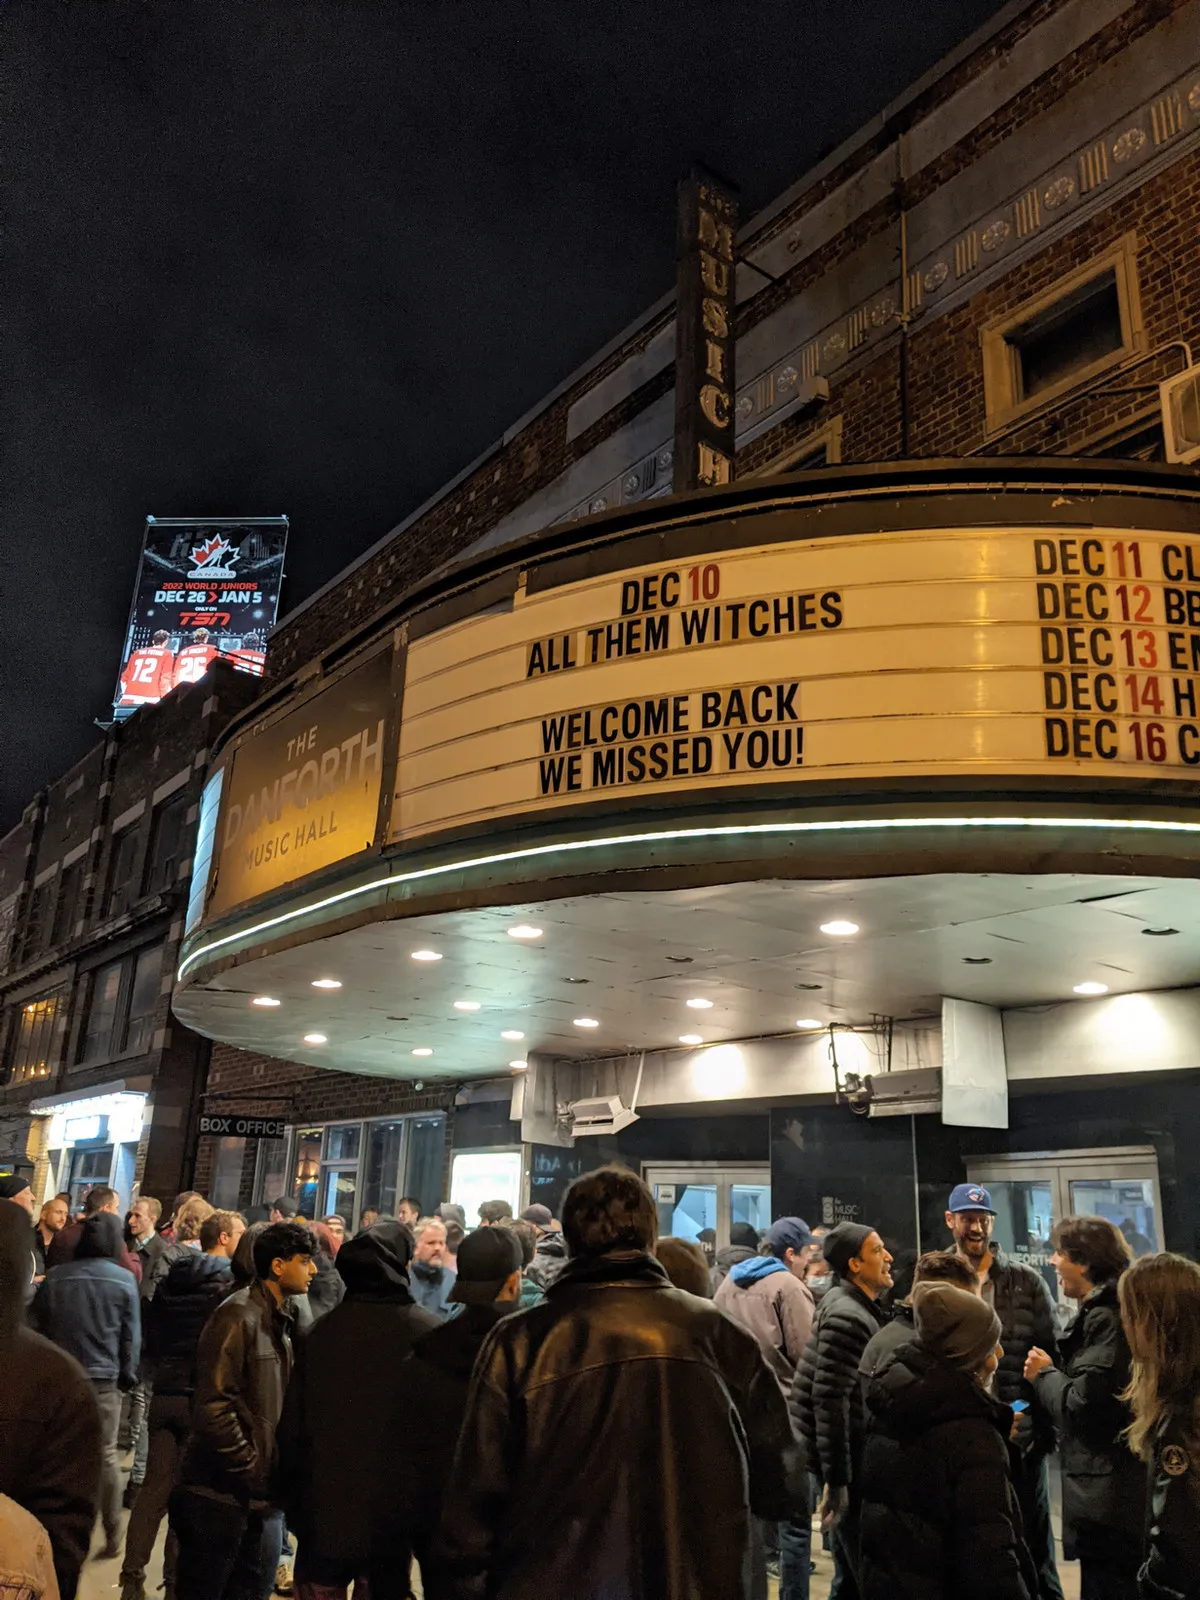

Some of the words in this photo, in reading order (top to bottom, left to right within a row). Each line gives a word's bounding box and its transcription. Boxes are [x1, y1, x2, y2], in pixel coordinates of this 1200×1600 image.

[1033, 538, 1105, 577] DEC
[1112, 541, 1143, 578] 11
[1161, 543, 1200, 582] CL
[154, 590, 186, 603] DEC
[187, 591, 206, 603] 26
[218, 591, 251, 603] JAN
[252, 591, 263, 603] 5
[162, 582, 184, 590] 2022
[184, 582, 218, 590] WORLD
[219, 582, 258, 590] JUNIORS
[621, 571, 680, 616] DEC
[688, 563, 720, 601] 10
[1036, 582, 1109, 621] DEC
[1115, 584, 1154, 623] 12
[179, 611, 231, 626] TSN
[526, 635, 576, 678] ALL
[587, 614, 670, 663] THEM
[681, 591, 843, 646] WITCHES
[179, 656, 207, 683] 26
[1040, 627, 1114, 666] DEC
[1120, 629, 1158, 669] 13
[132, 657, 158, 683] 12
[1043, 671, 1118, 712] DEC
[1125, 673, 1164, 715] 14
[1172, 678, 1196, 717] H
[541, 695, 689, 753] WELCOME
[701, 682, 799, 729] BACK
[287, 725, 318, 762] THE
[539, 755, 582, 795] WE
[592, 736, 713, 788] MISSED
[722, 726, 804, 771] YOU!
[1045, 717, 1118, 759] DEC
[1129, 721, 1167, 763] 16
[223, 718, 385, 850] DANFORTH
[245, 832, 290, 872] MUSIC
[294, 810, 338, 850] HALL
[200, 1117, 232, 1133] BOX
[236, 1120, 285, 1136] OFFICE
